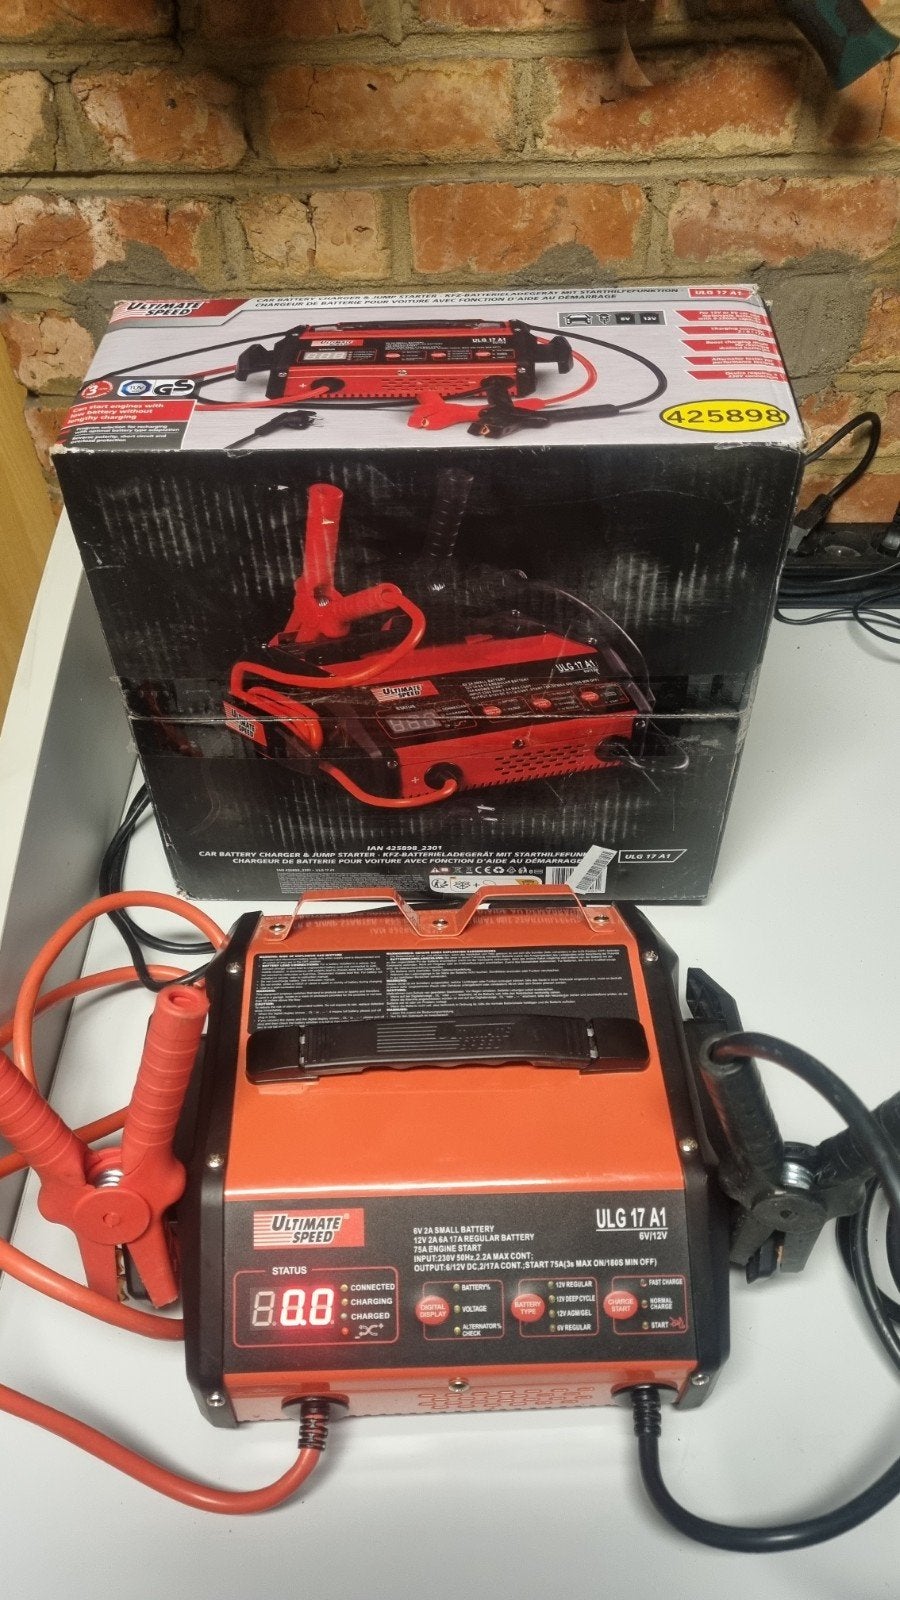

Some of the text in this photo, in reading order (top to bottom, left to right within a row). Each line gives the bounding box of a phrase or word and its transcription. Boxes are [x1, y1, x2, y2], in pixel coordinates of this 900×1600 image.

[127, 302, 200, 310] ULTIMATE
[154, 380, 194, 396] GS
[666, 409, 784, 423] 425898
[555, 661, 575, 673] ULG
[576, 661, 584, 670] 17
[584, 660, 596, 668] A1
[383, 685, 422, 695] ULTIMATE
[596, 1206, 667, 1229] ULG 17 A1
[271, 1215, 343, 1232] ULTIMATE
[413, 1225, 495, 1235] 6V 2A SMALL BATTERY
[292, 1231, 334, 1244] SPEED
[413, 1236, 427, 1244] 12V
[449, 1235, 463, 1243] 17A
[463, 1234, 500, 1242] REGULAR
[501, 1233, 535, 1241] BATTERY
[639, 1231, 668, 1241] 6V/12V
[413, 1244, 482, 1253] 75A ENGINE START
[413, 1263, 466, 1272] OUTPUT:6/12V
[576, 1259, 592, 1267] MAX
[625, 1258, 639, 1266] MIN
[640, 1258, 658, 1267] OFF)
[271, 1266, 307, 1276] STATUS
[350, 1283, 395, 1291] CONNECTED
[662, 1278, 683, 1286] CHARGE
[350, 1297, 393, 1306] CHARGING
[462, 1305, 487, 1313] VOLTAGE
[350, 1312, 390, 1320] CHARGED
[651, 1321, 669, 1329] START
